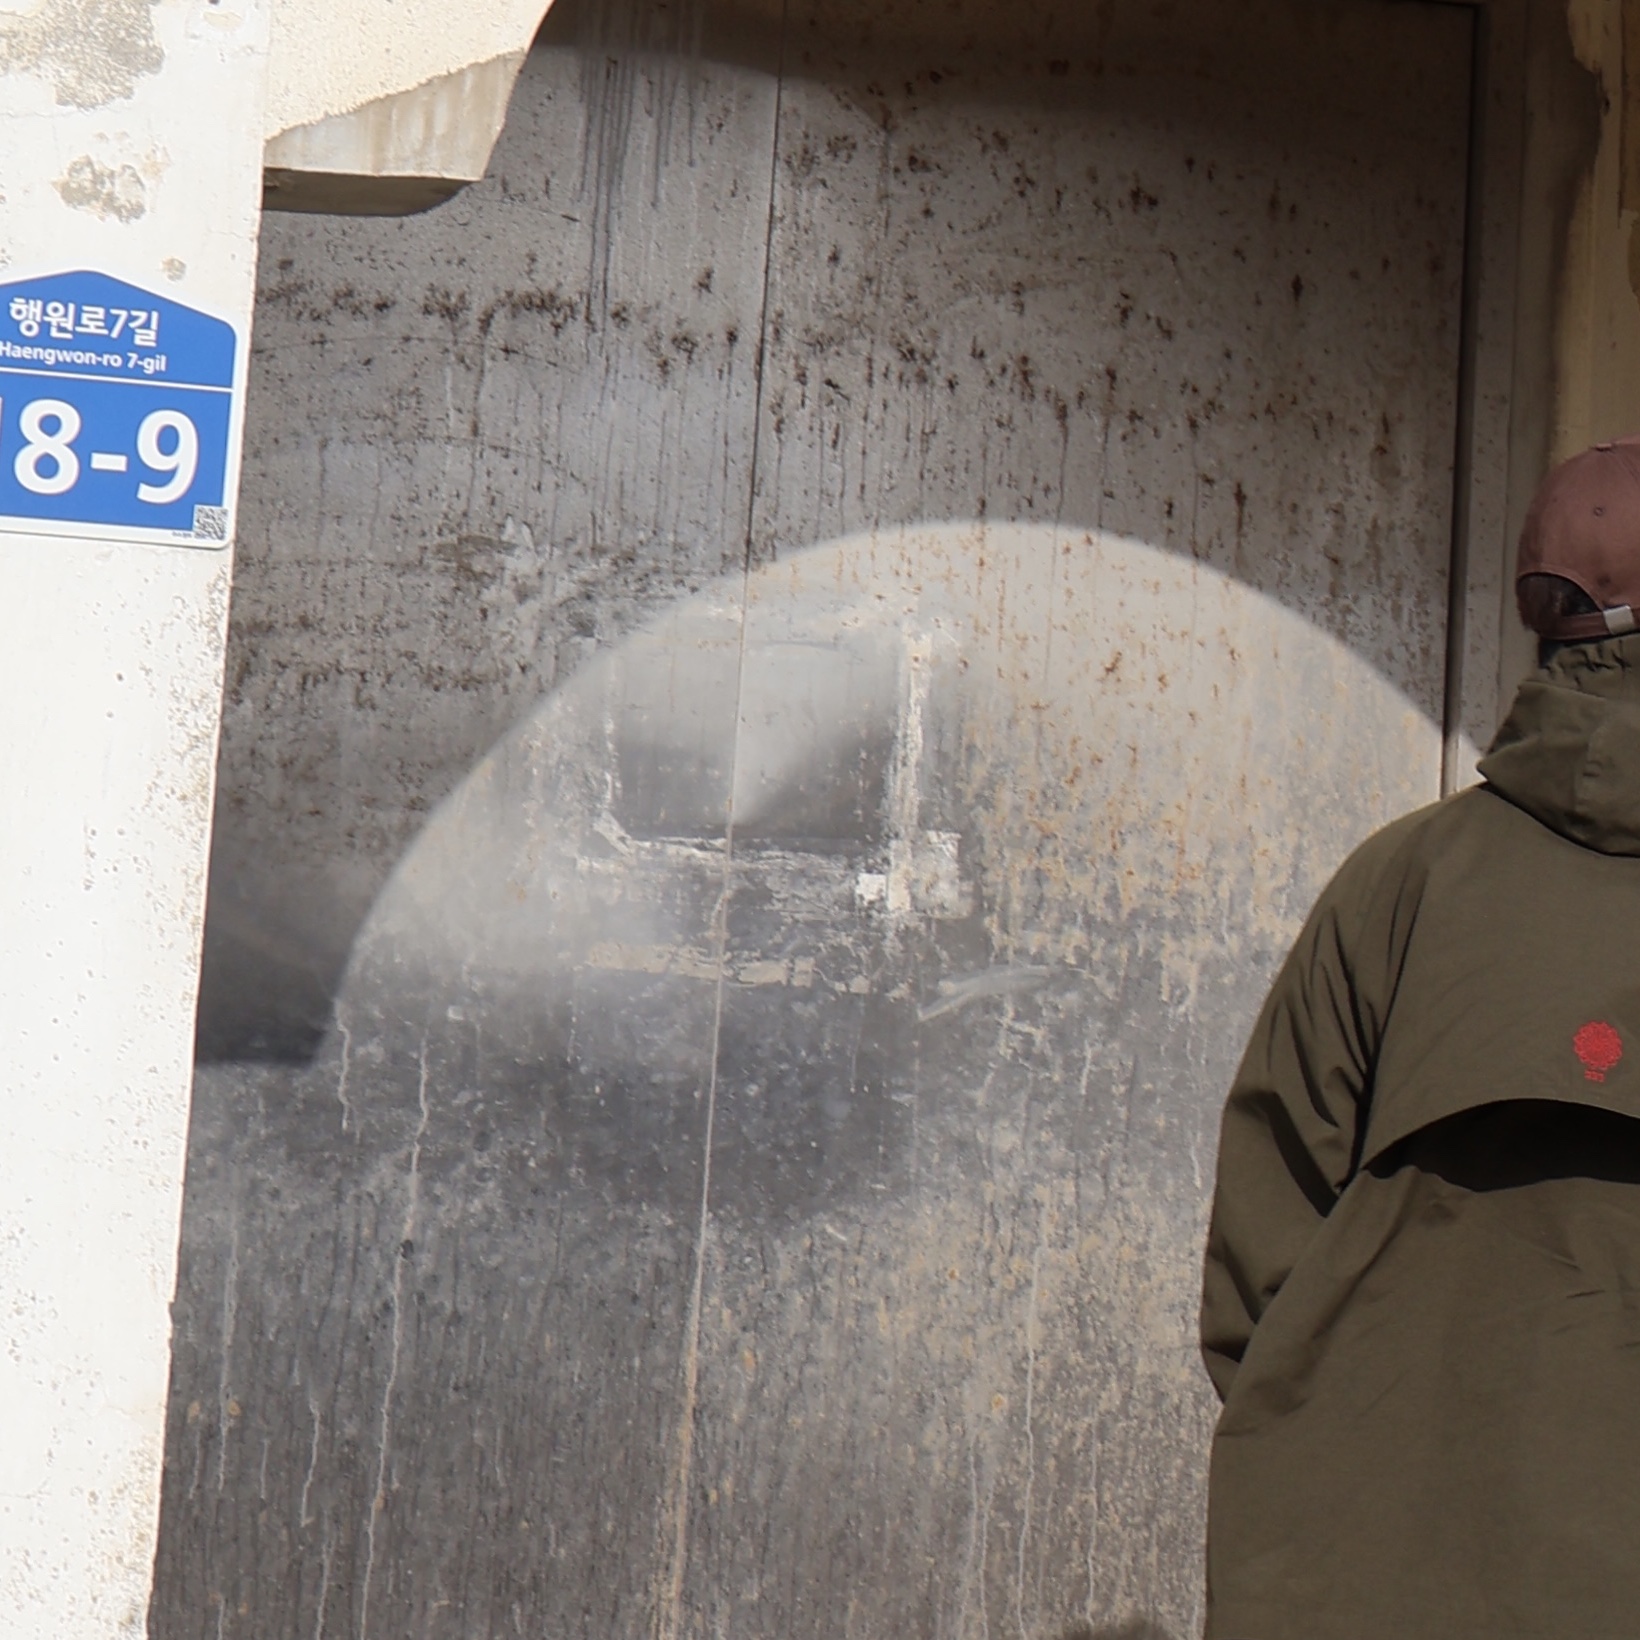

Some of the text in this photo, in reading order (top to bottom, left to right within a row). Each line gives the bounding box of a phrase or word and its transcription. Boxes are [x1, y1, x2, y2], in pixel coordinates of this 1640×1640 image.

[9, 297, 159, 347] 행원로7길
[0, 340, 167, 375] Haengwon-ro 7-gil
[0, 397, 199, 504] 8-9
